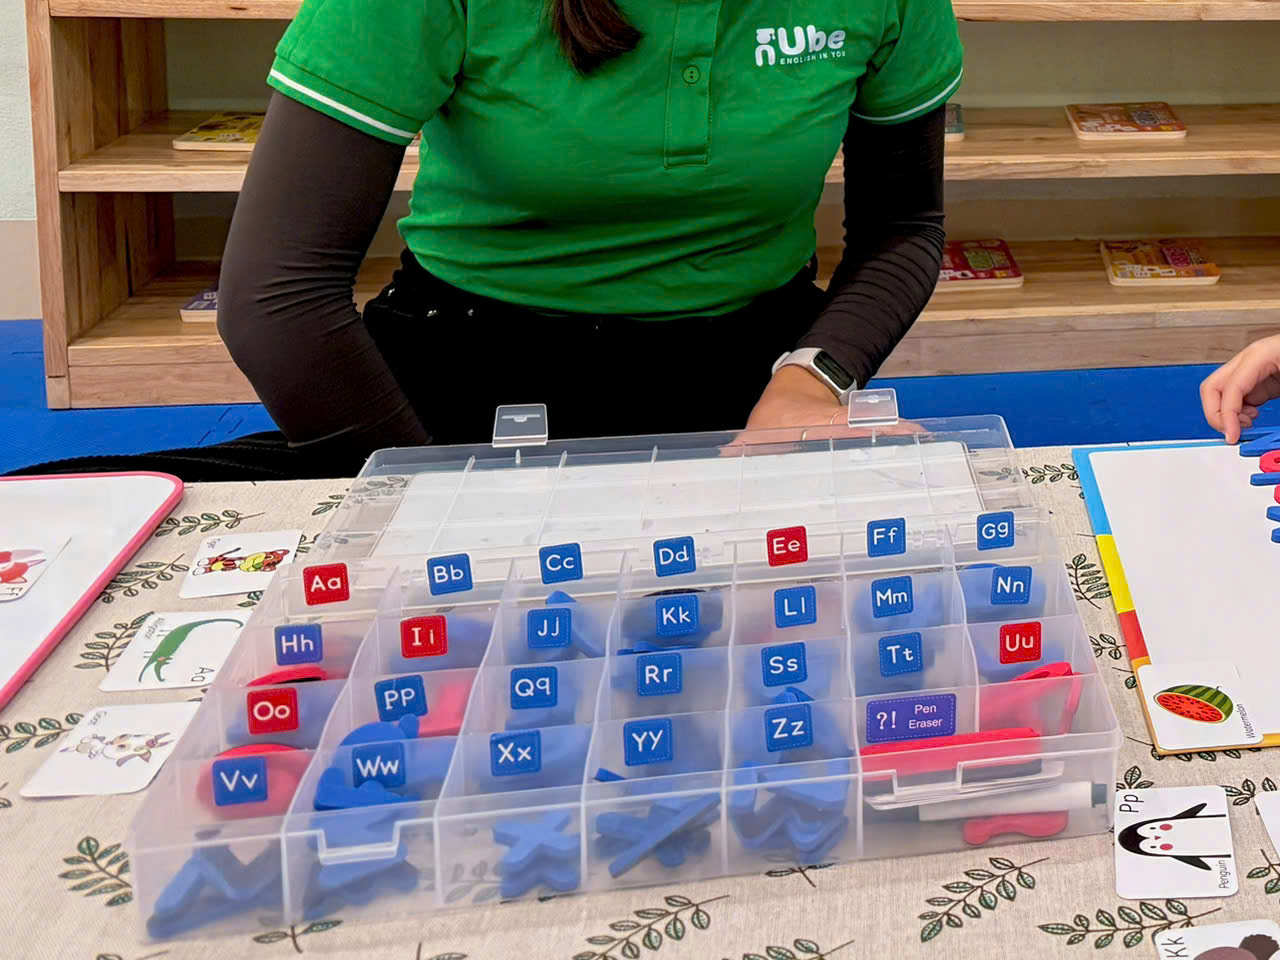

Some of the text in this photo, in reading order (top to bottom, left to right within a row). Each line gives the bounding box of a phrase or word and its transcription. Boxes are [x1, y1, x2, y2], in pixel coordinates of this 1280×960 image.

[780, 54, 817, 65] ENGLISH
[819, 52, 828, 60] IN
[872, 527, 897, 545] Ff
[982, 521, 1009, 541] Gg
[658, 545, 690, 566] Dd
[773, 538, 801, 556] Ee
[546, 554, 575, 573] Cc
[311, 574, 343, 594] Aa
[434, 565, 464, 584] Bb
[997, 575, 1026, 594] Nn
[876, 586, 908, 606] Mm
[662, 606, 691, 626] Kk
[784, 597, 806, 617] Ll
[411, 627, 436, 646] Ii
[537, 618, 561, 639] Jj
[281, 634, 315, 654] Hh
[1004, 634, 1035, 653] Uu
[769, 655, 798, 675] Ss
[886, 645, 914, 665] Tt
[190, 666, 215, 682] Aa
[645, 665, 674, 685] Rr
[515, 676, 552, 697] Qq
[384, 686, 416, 710] Pp
[253, 700, 290, 720] Oo
[914, 702, 938, 716] Pen
[771, 717, 804, 739] Zz
[908, 716, 943, 730] Eraser
[631, 728, 663, 752] Yy
[498, 741, 533, 764] Xx
[356, 755, 400, 779] Ww
[221, 769, 258, 791] Vv
[1119, 792, 1144, 813] Pp
[1218, 858, 1230, 889] Penguin
[1160, 935, 1190, 959] Kk
